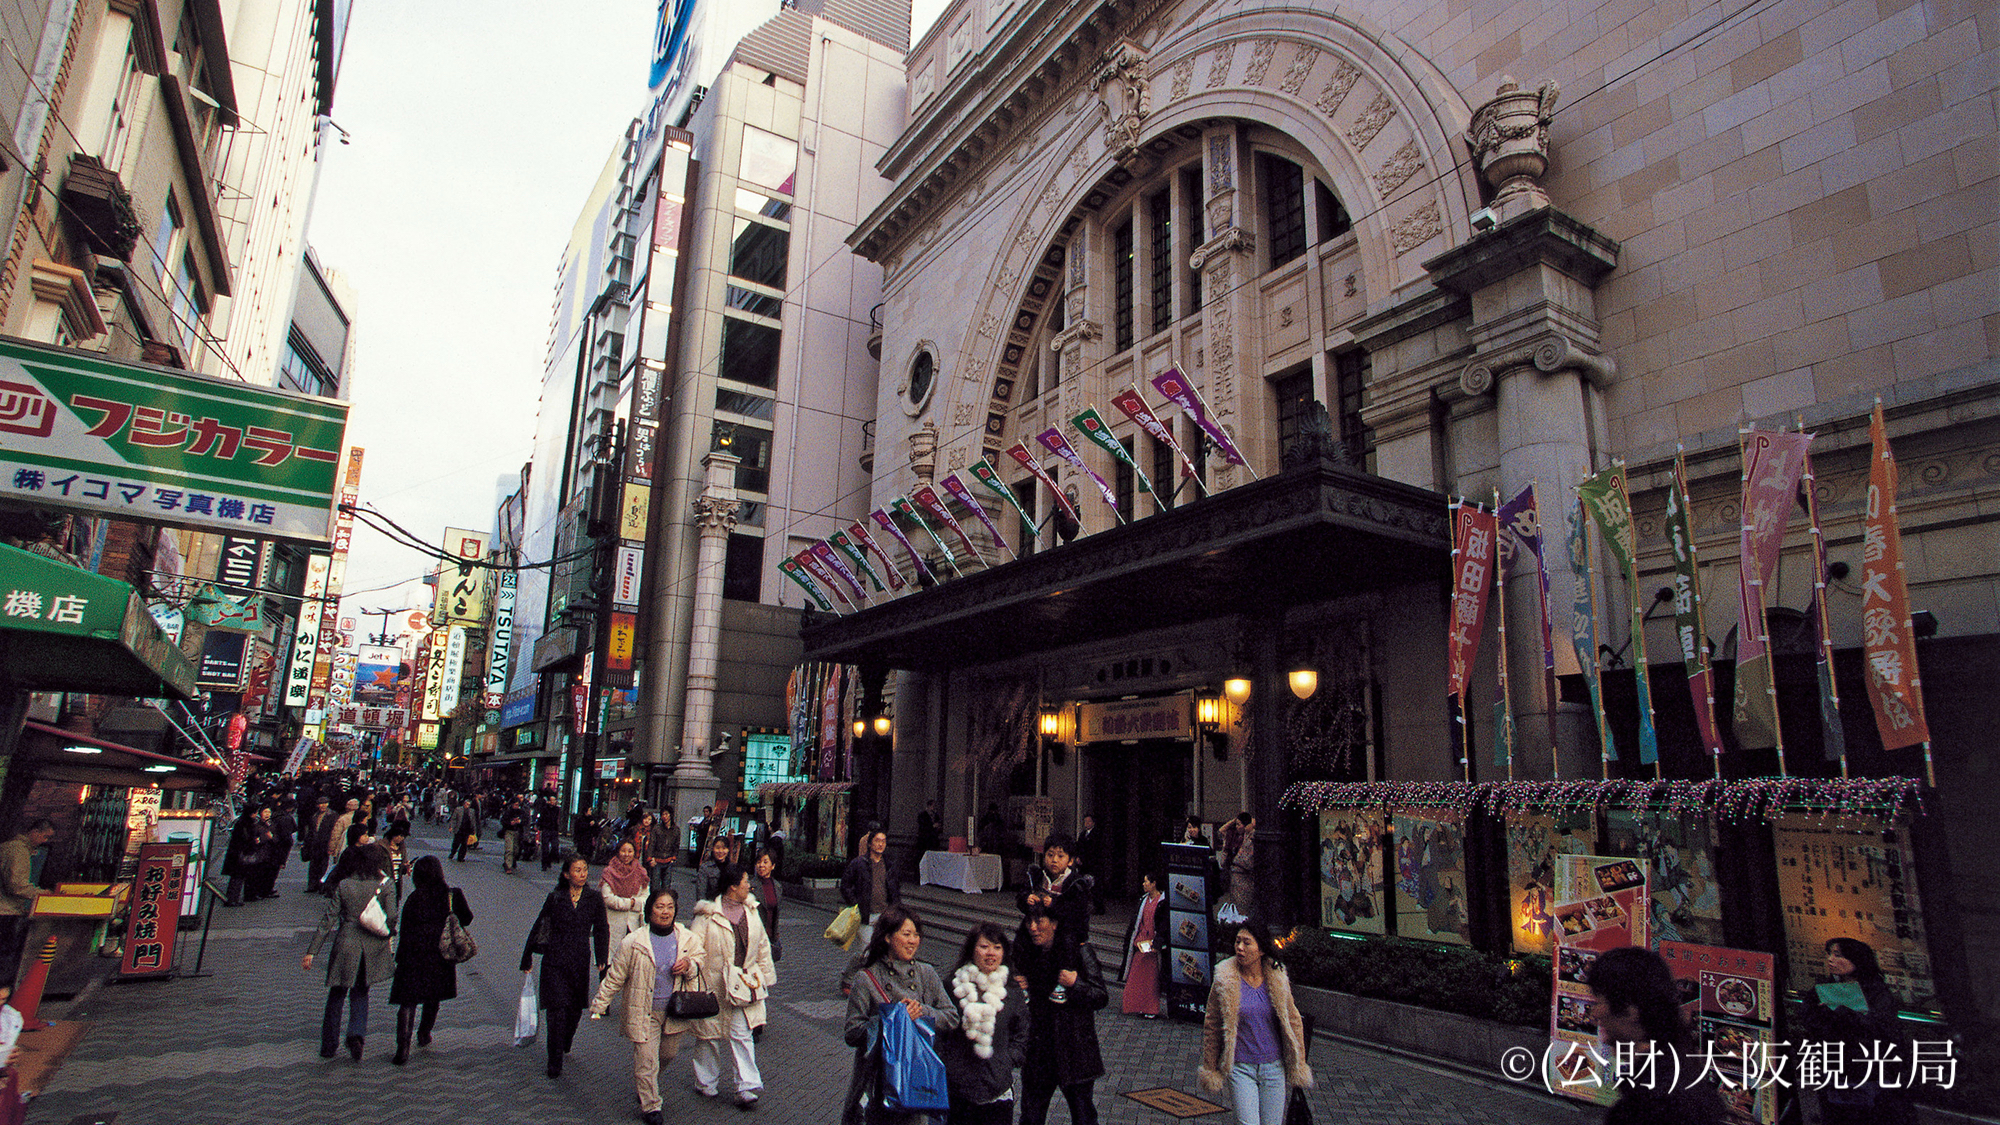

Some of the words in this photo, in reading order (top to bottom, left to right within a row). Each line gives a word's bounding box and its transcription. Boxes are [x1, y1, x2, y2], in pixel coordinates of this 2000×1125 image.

[70, 393, 338, 467] フジカラー
[4, 590, 89, 624] 機店
[489, 606, 514, 685] TSUTAYA
[339, 707, 405, 728] 道頓堀
[487, 695, 502, 707] 本
